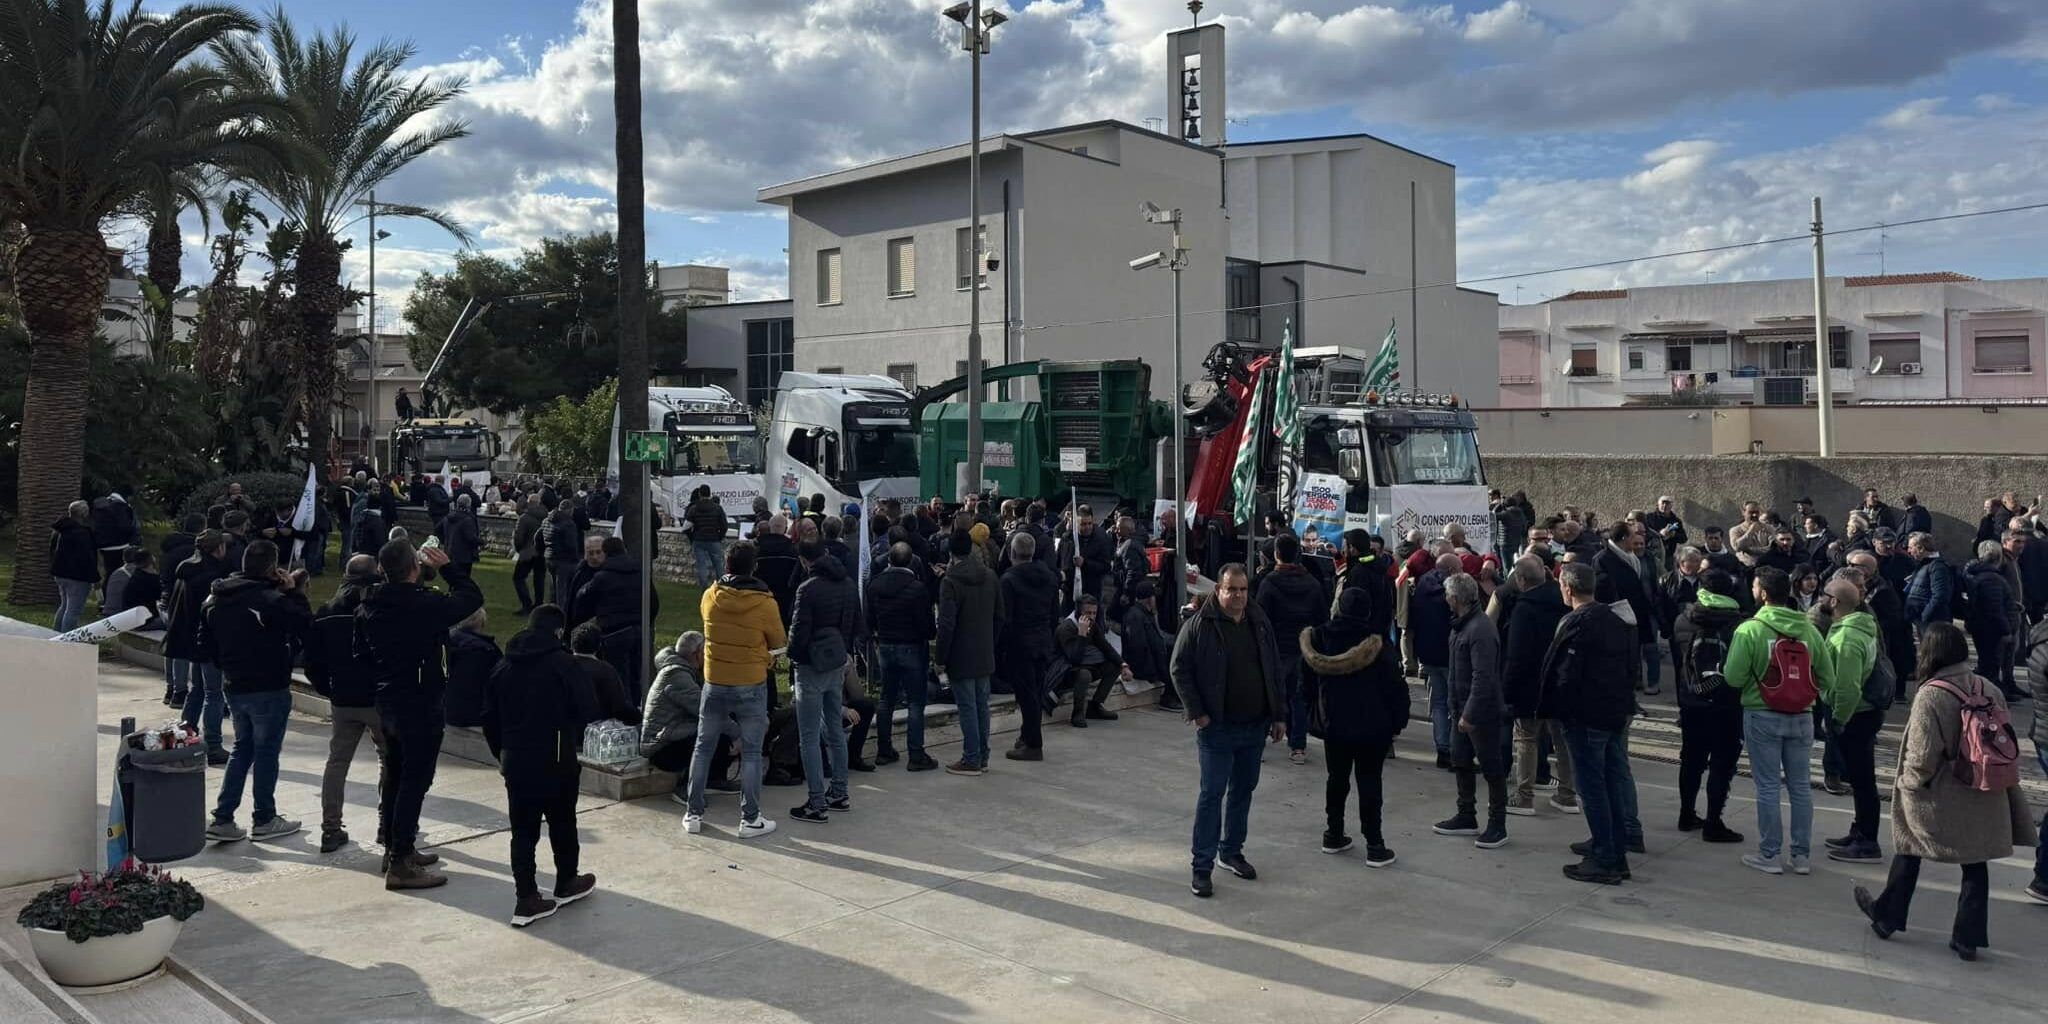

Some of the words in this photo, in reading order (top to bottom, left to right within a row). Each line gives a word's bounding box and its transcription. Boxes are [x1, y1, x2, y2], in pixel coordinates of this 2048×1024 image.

[737, 489, 760, 498] LEGNO
[1301, 491, 1341, 500] PERSONE
[1306, 496, 1334, 505] SENZA
[1303, 502, 1337, 511] LAVORO
[1421, 514, 1467, 526] CONSORZIO
[1467, 514, 1489, 526] LEGNO
